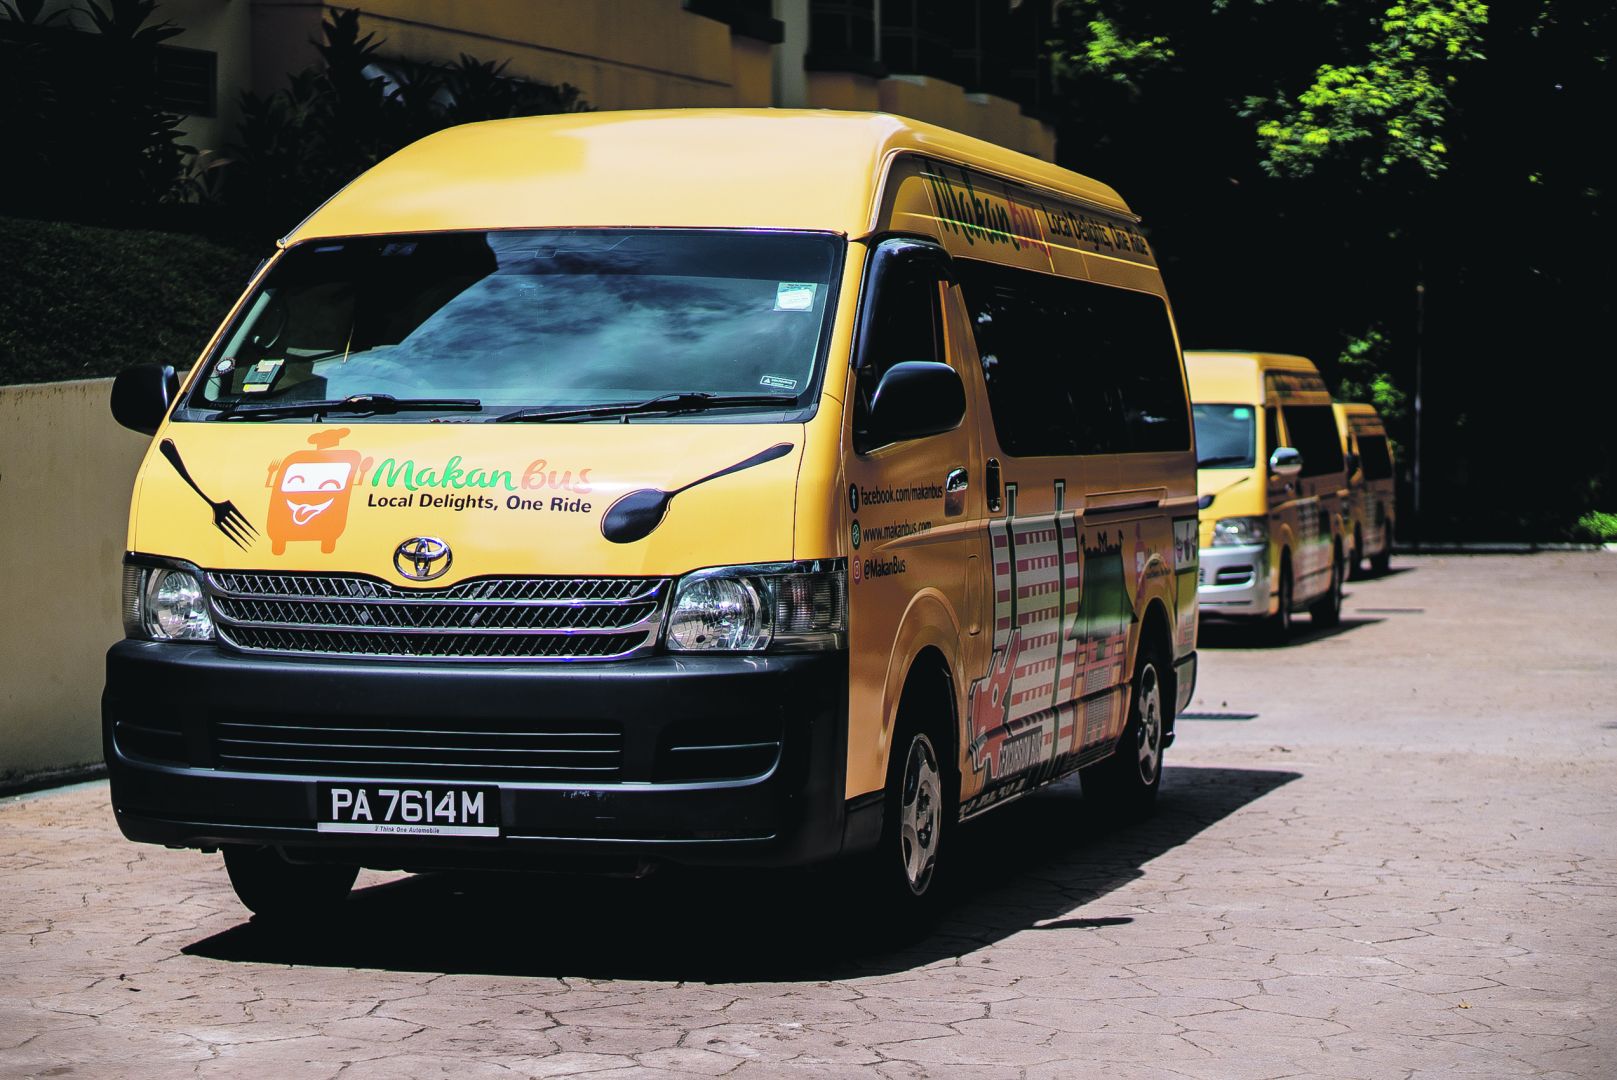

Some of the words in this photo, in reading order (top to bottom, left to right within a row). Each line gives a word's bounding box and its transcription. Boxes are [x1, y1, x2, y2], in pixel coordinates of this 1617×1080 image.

[371, 455, 518, 492] Makan
[521, 458, 592, 494] Bus
[368, 493, 413, 508] Local
[420, 493, 498, 511] Delights,
[506, 495, 543, 511] One
[550, 497, 592, 513] Ride
[860, 481, 943, 506] facebook.com/makanbus
[863, 519, 932, 542] www.makanbus.com
[863, 555, 906, 580] @MakanBus
[331, 788, 373, 821] PA
